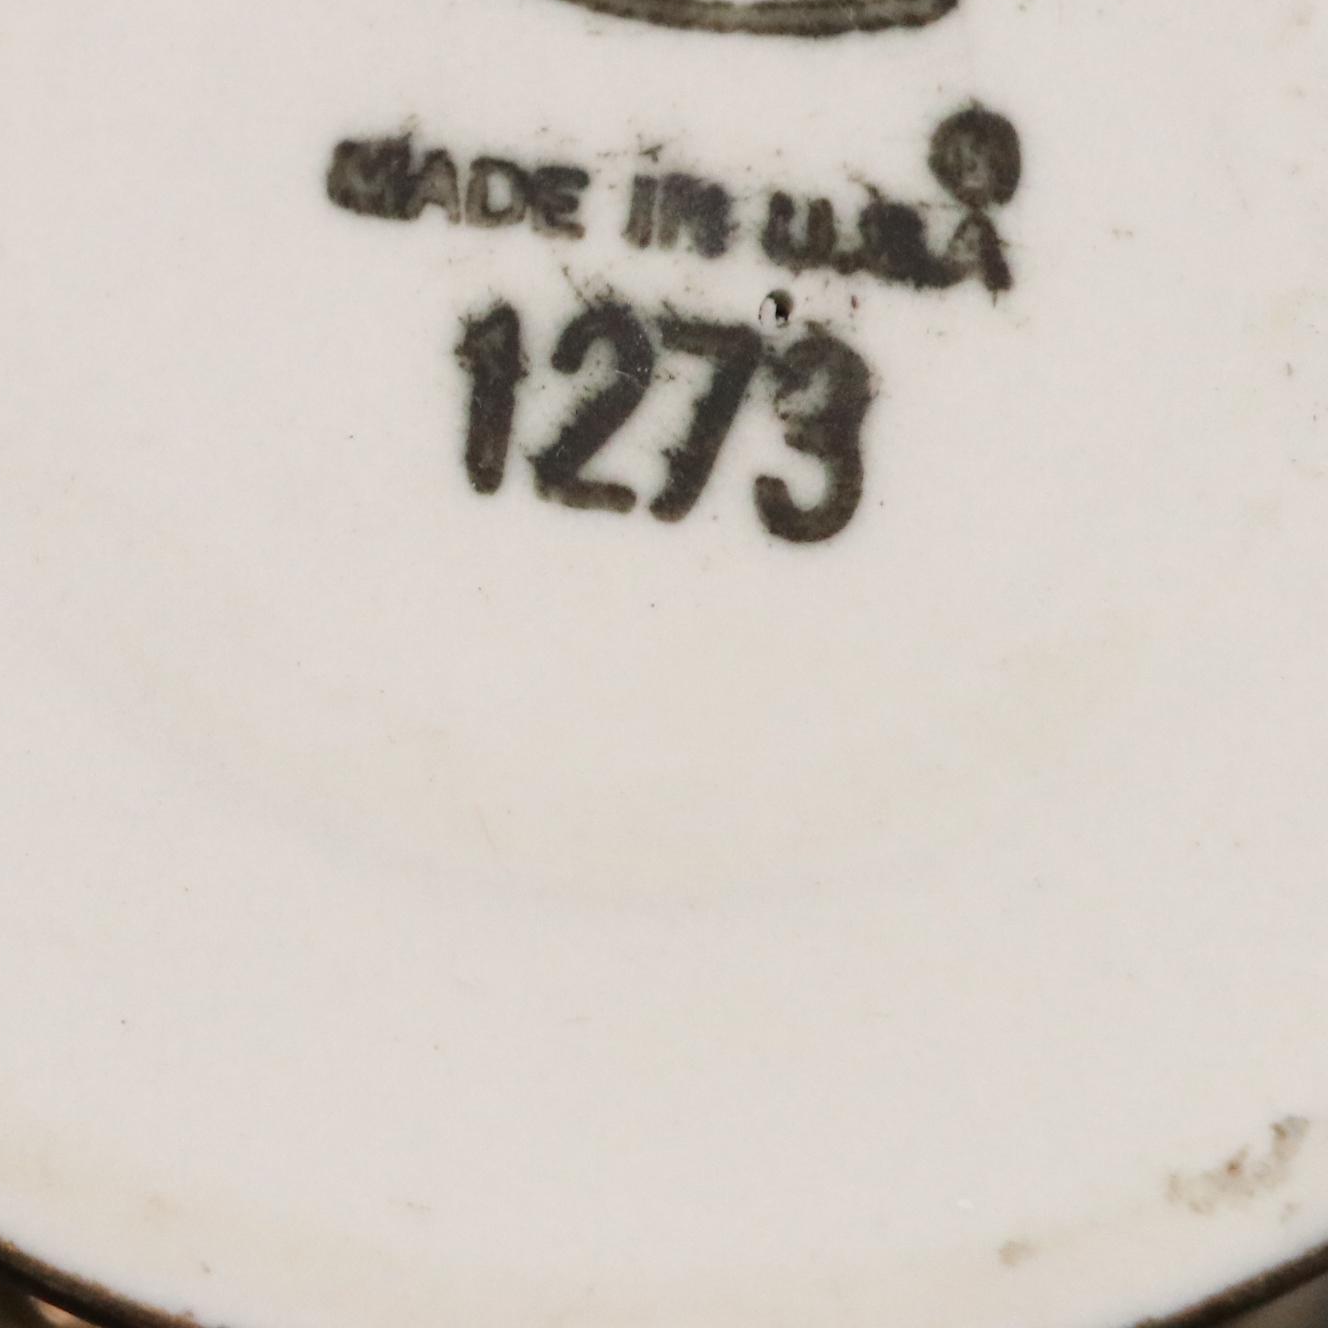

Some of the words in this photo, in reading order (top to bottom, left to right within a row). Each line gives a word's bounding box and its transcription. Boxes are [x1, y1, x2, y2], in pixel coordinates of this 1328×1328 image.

[326, 135, 590, 239] MADE
[623, 172, 732, 258] IN
[760, 190, 1013, 292] U..A
[457, 300, 874, 544] 1273
